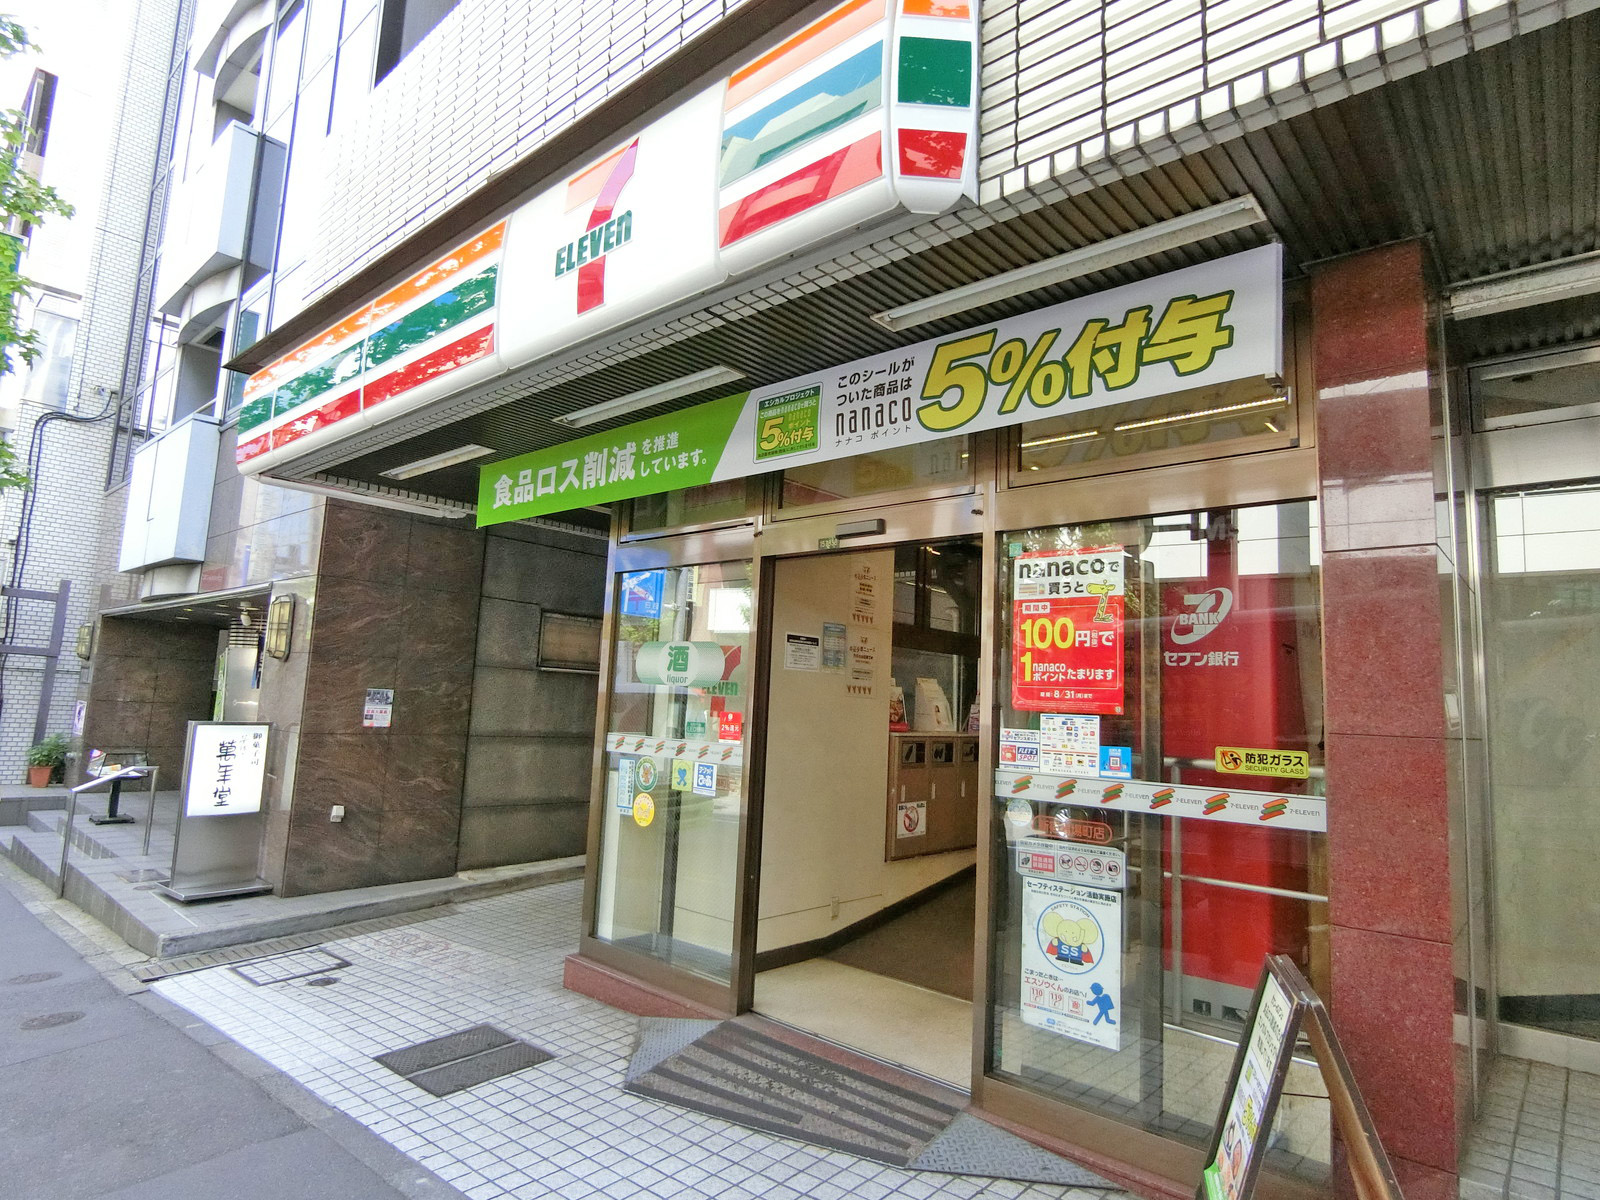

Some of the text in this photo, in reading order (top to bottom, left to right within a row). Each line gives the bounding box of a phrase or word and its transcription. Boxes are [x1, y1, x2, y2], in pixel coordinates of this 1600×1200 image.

[916, 289, 1234, 433] 5%付与
[837, 356, 915, 389] このシールが
[836, 376, 912, 407] ついた商品は
[836, 396, 911, 437] nanaco
[760, 416, 814, 451] 5%付与
[641, 431, 679, 456] を推進
[640, 447, 707, 478] しています。
[493, 441, 636, 510] 食品ロス削減
[1048, 580, 1084, 595] 買うと
[1179, 611, 1221, 625] BANK
[667, 646, 690, 672] 酒
[1164, 651, 1239, 667] セブン銀行
[1032, 663, 1066, 672] nanaco
[1067, 668, 1114, 681] たまります
[666, 675, 689, 684] liquor
[1032, 671, 1066, 682] ポイント
[1018, 754, 1037, 762] SPOT
[1245, 752, 1305, 767] 防犯ガラス
[1245, 765, 1305, 775] SECURITY GLASS
[1060, 944, 1080, 957] SS
[1031, 987, 1063, 1002] 110 119
